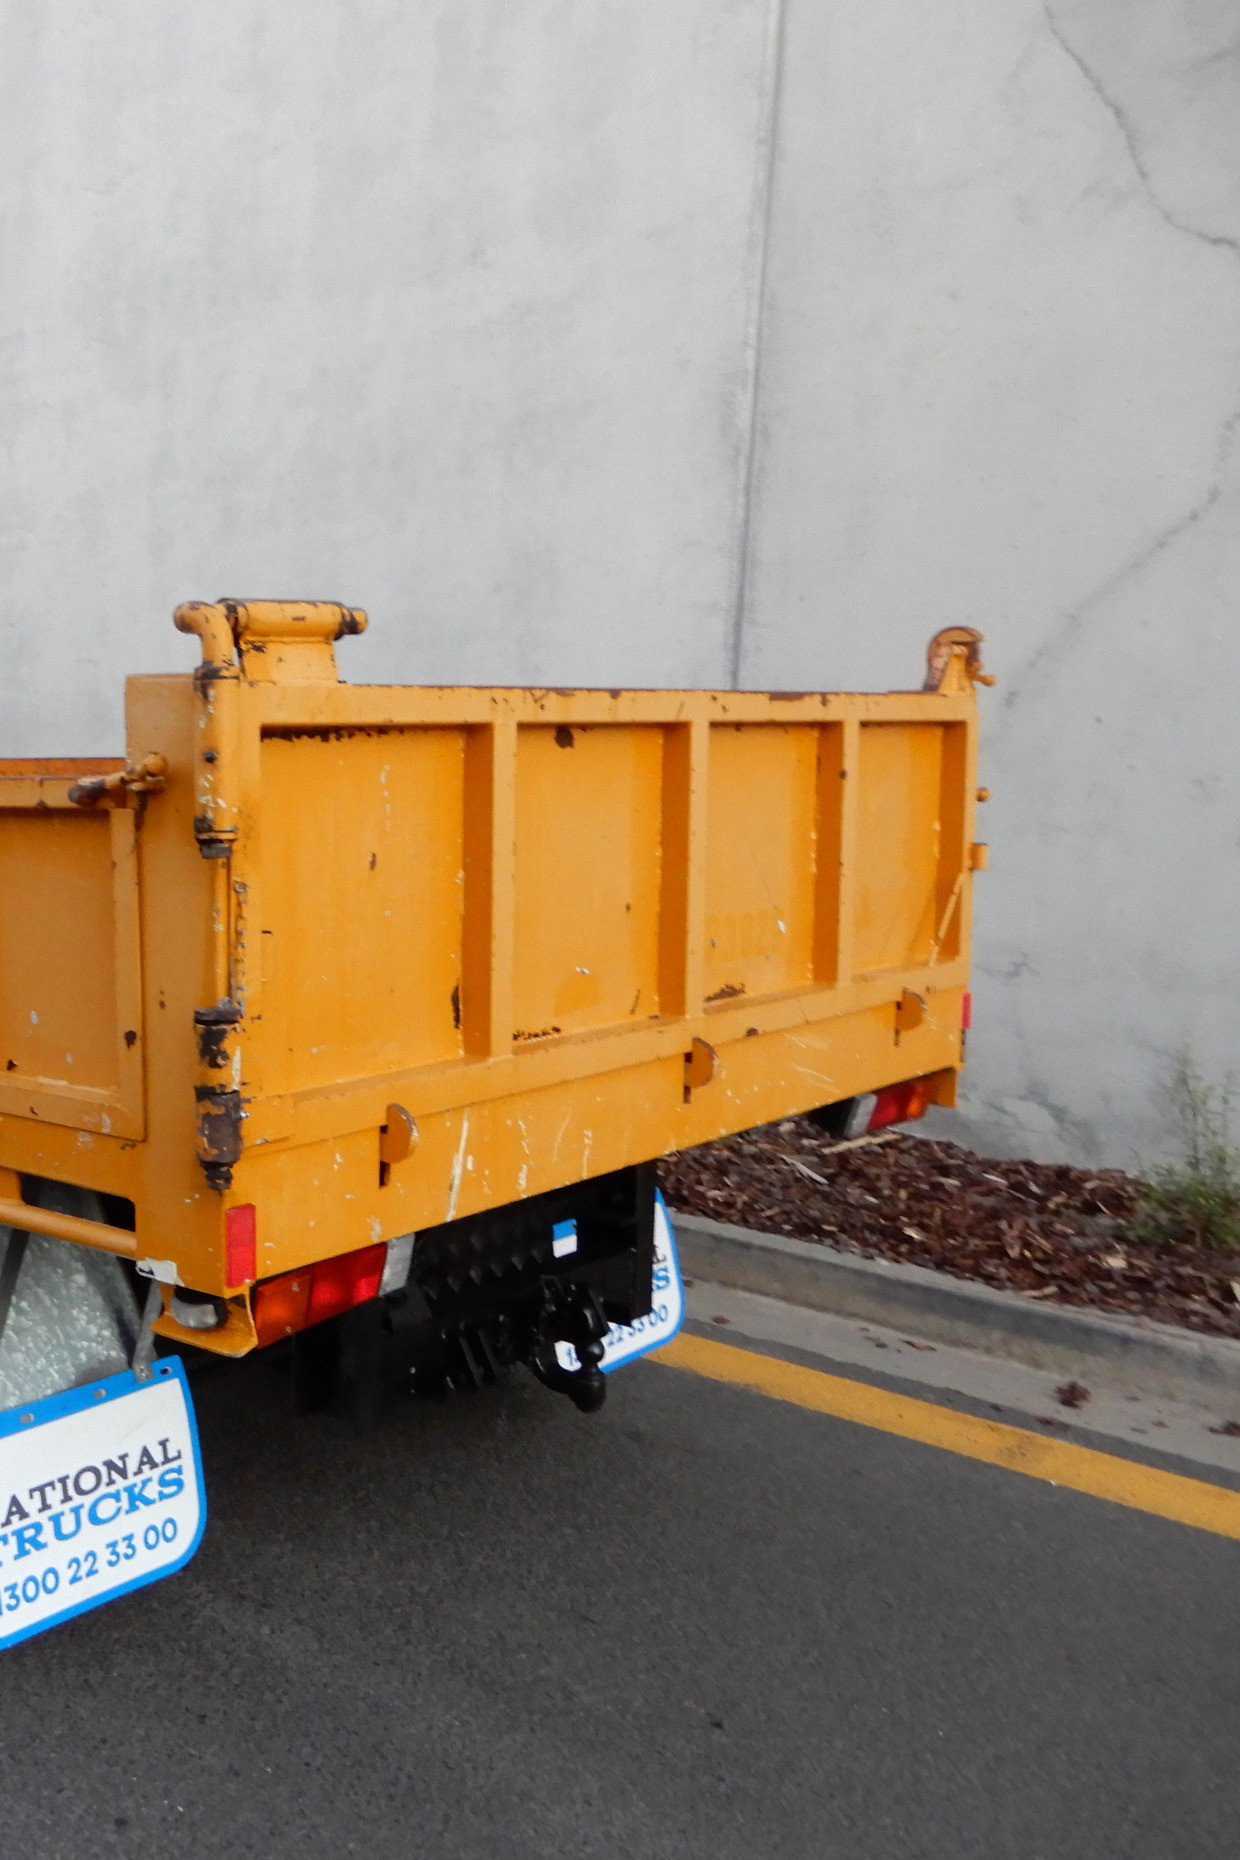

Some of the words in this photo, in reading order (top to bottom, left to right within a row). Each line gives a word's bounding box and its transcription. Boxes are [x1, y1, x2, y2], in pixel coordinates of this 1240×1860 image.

[647, 1304, 668, 1327] 00
[67, 1549, 99, 1586] 22
[105, 1532, 138, 1568] 33
[144, 1516, 179, 1550] 00
